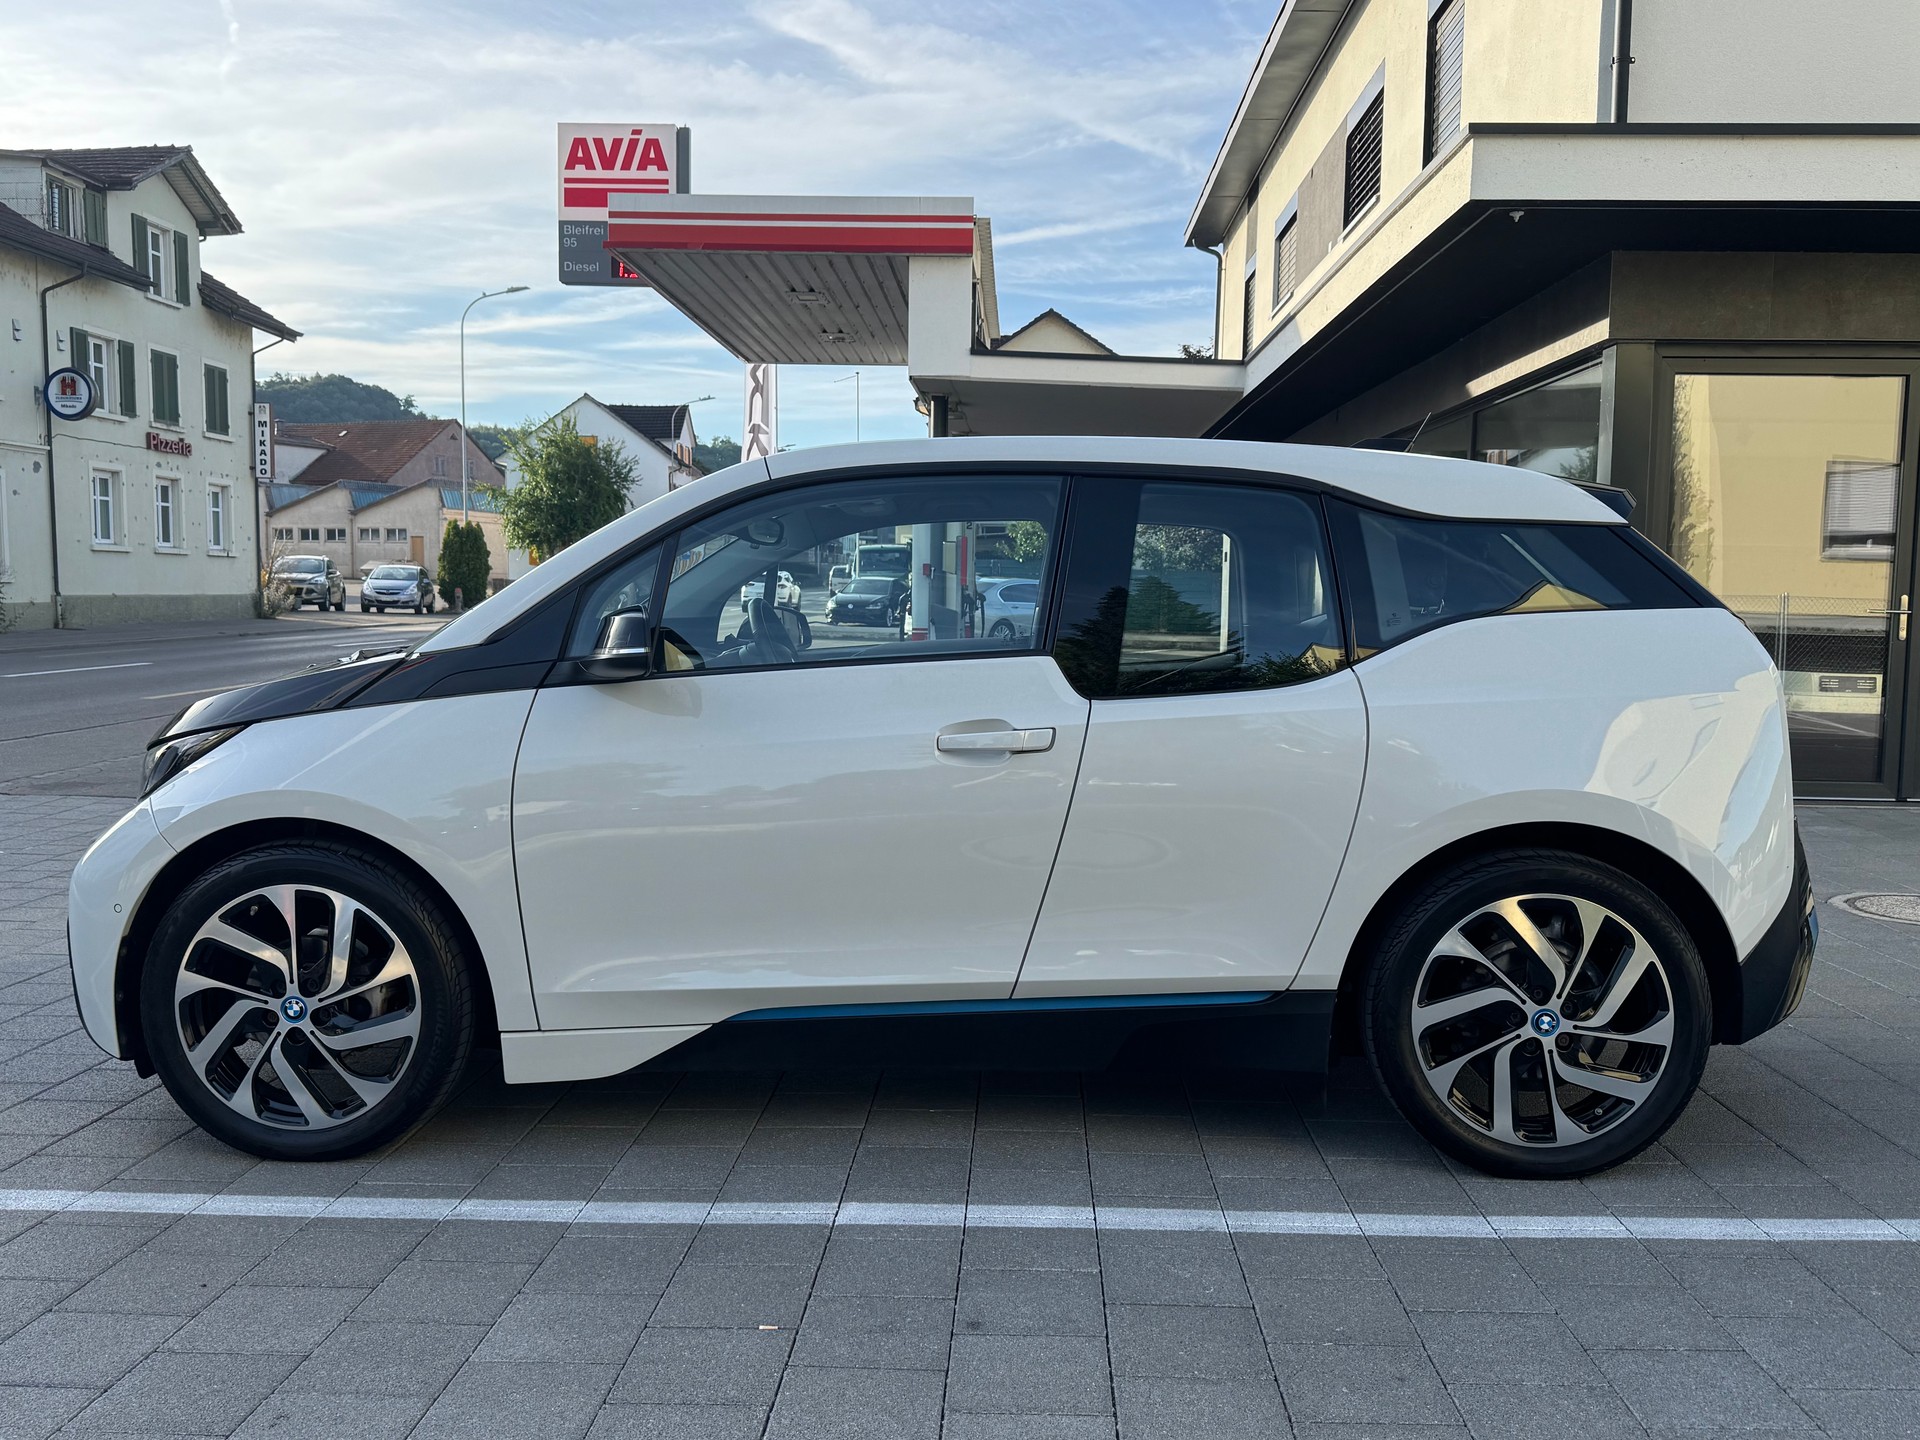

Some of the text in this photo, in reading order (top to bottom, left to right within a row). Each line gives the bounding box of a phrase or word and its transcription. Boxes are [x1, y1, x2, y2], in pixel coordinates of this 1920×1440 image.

[564, 128, 669, 171] AVIA
[563, 224, 604, 235] Bleifrei
[563, 237, 578, 248] 95
[563, 261, 600, 272] Diesel
[149, 432, 193, 457] Pizzeria
[257, 420, 268, 476] MIKADO
